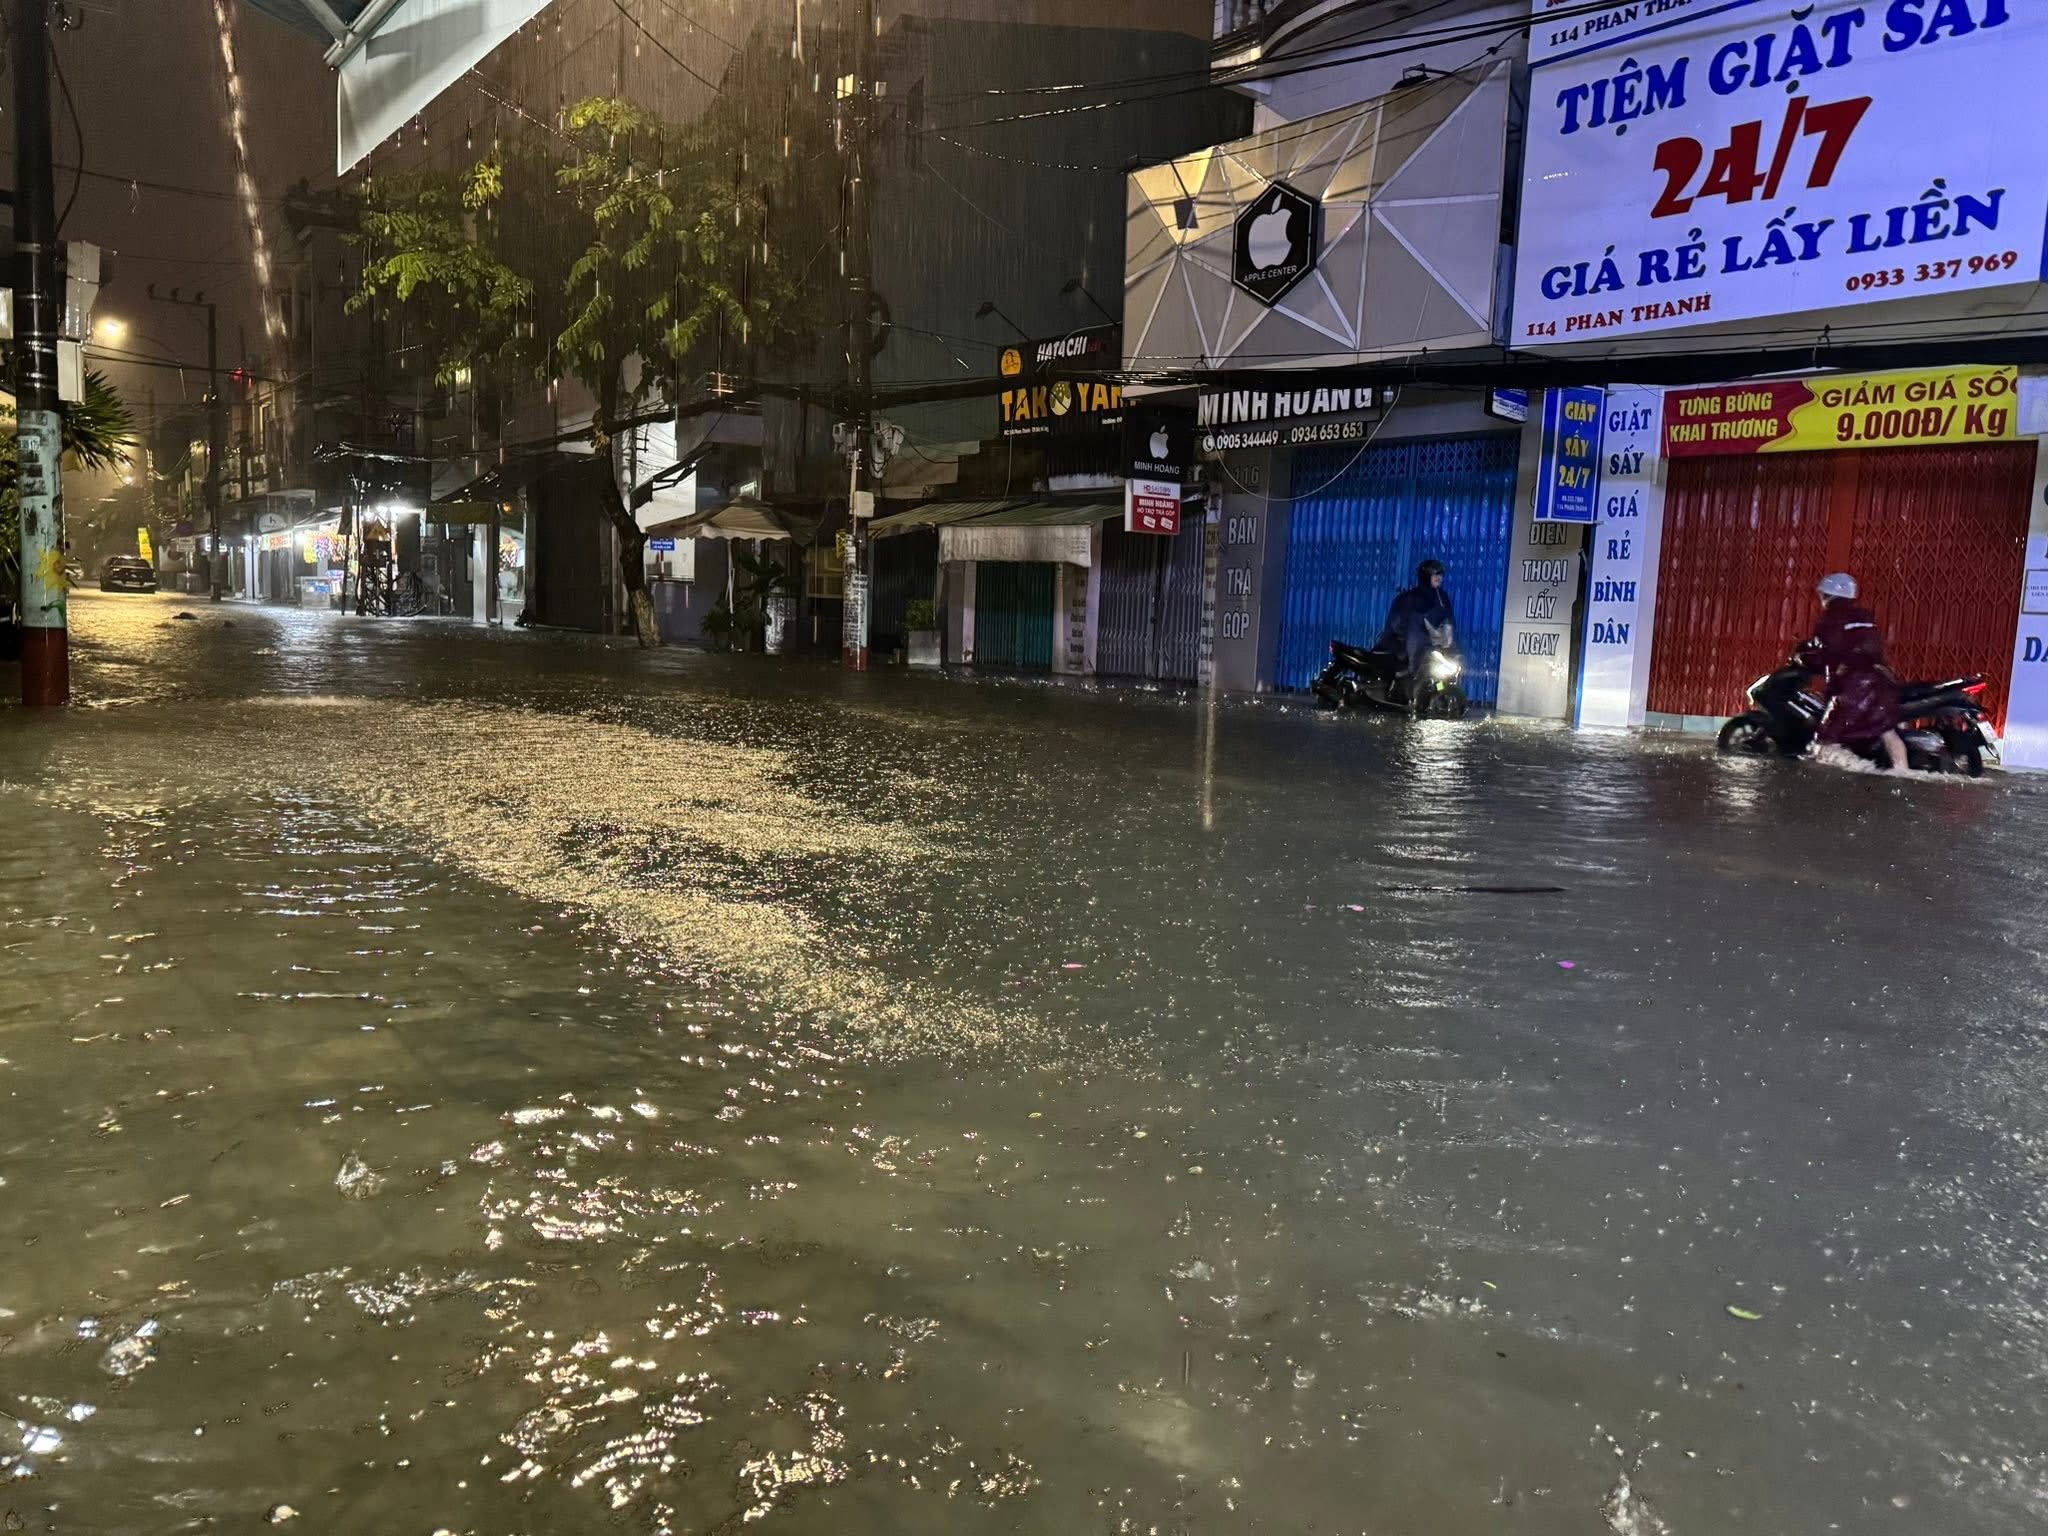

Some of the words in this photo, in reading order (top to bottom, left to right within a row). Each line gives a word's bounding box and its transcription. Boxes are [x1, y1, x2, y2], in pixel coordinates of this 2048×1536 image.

[1550, 26, 1578, 46] 114
[1584, 5, 1639, 35] PHAN
[1556, 57, 1690, 136] TIỆM
[1707, 3, 1865, 95] GIẶT
[1651, 95, 1872, 219] 24/7
[1541, 244, 1625, 300] GIÁ
[1636, 227, 1706, 287] RẺ
[1720, 205, 1835, 274] LẤY
[1845, 178, 2006, 254] LIỀN
[1243, 271, 1267, 283] APPLE
[1268, 265, 1298, 278] CENTER
[1846, 268, 1905, 291] 0933
[1913, 259, 1962, 282] 337
[1967, 251, 2018, 275] 969
[1526, 321, 1556, 337] 114
[1565, 309, 1624, 333] PHAN
[1631, 295, 1712, 322] THANH
[1037, 336, 1088, 362] HATACHI
[1822, 380, 1896, 408] GIẢM
[1904, 374, 1957, 402] GIÁ
[1197, 391, 1268, 426] MINH
[1608, 401, 1652, 437] GIẶT
[1291, 428, 1318, 443] 0934
[1319, 424, 1341, 440] 653
[1342, 421, 1364, 438] 653
[1565, 429, 1590, 458] SẤY
[1669, 423, 1706, 442] KHAI
[1711, 418, 1779, 440] TRƯƠNG
[1134, 461, 1153, 472] MINH
[1609, 444, 1645, 475] SẤY
[1558, 465, 1591, 489] 24/7
[1607, 489, 1640, 518] GIÁ
[1228, 511, 1258, 545] BÁN
[1606, 530, 1632, 560] RẺ
[1522, 559, 1569, 587] THOẠI
[1593, 575, 1637, 602] BÌNH
[1525, 588, 1557, 620] LẤY
[1222, 607, 1250, 640] GÓP
[1592, 617, 1630, 644] DÂN
[1517, 631, 1560, 657] NGAY
